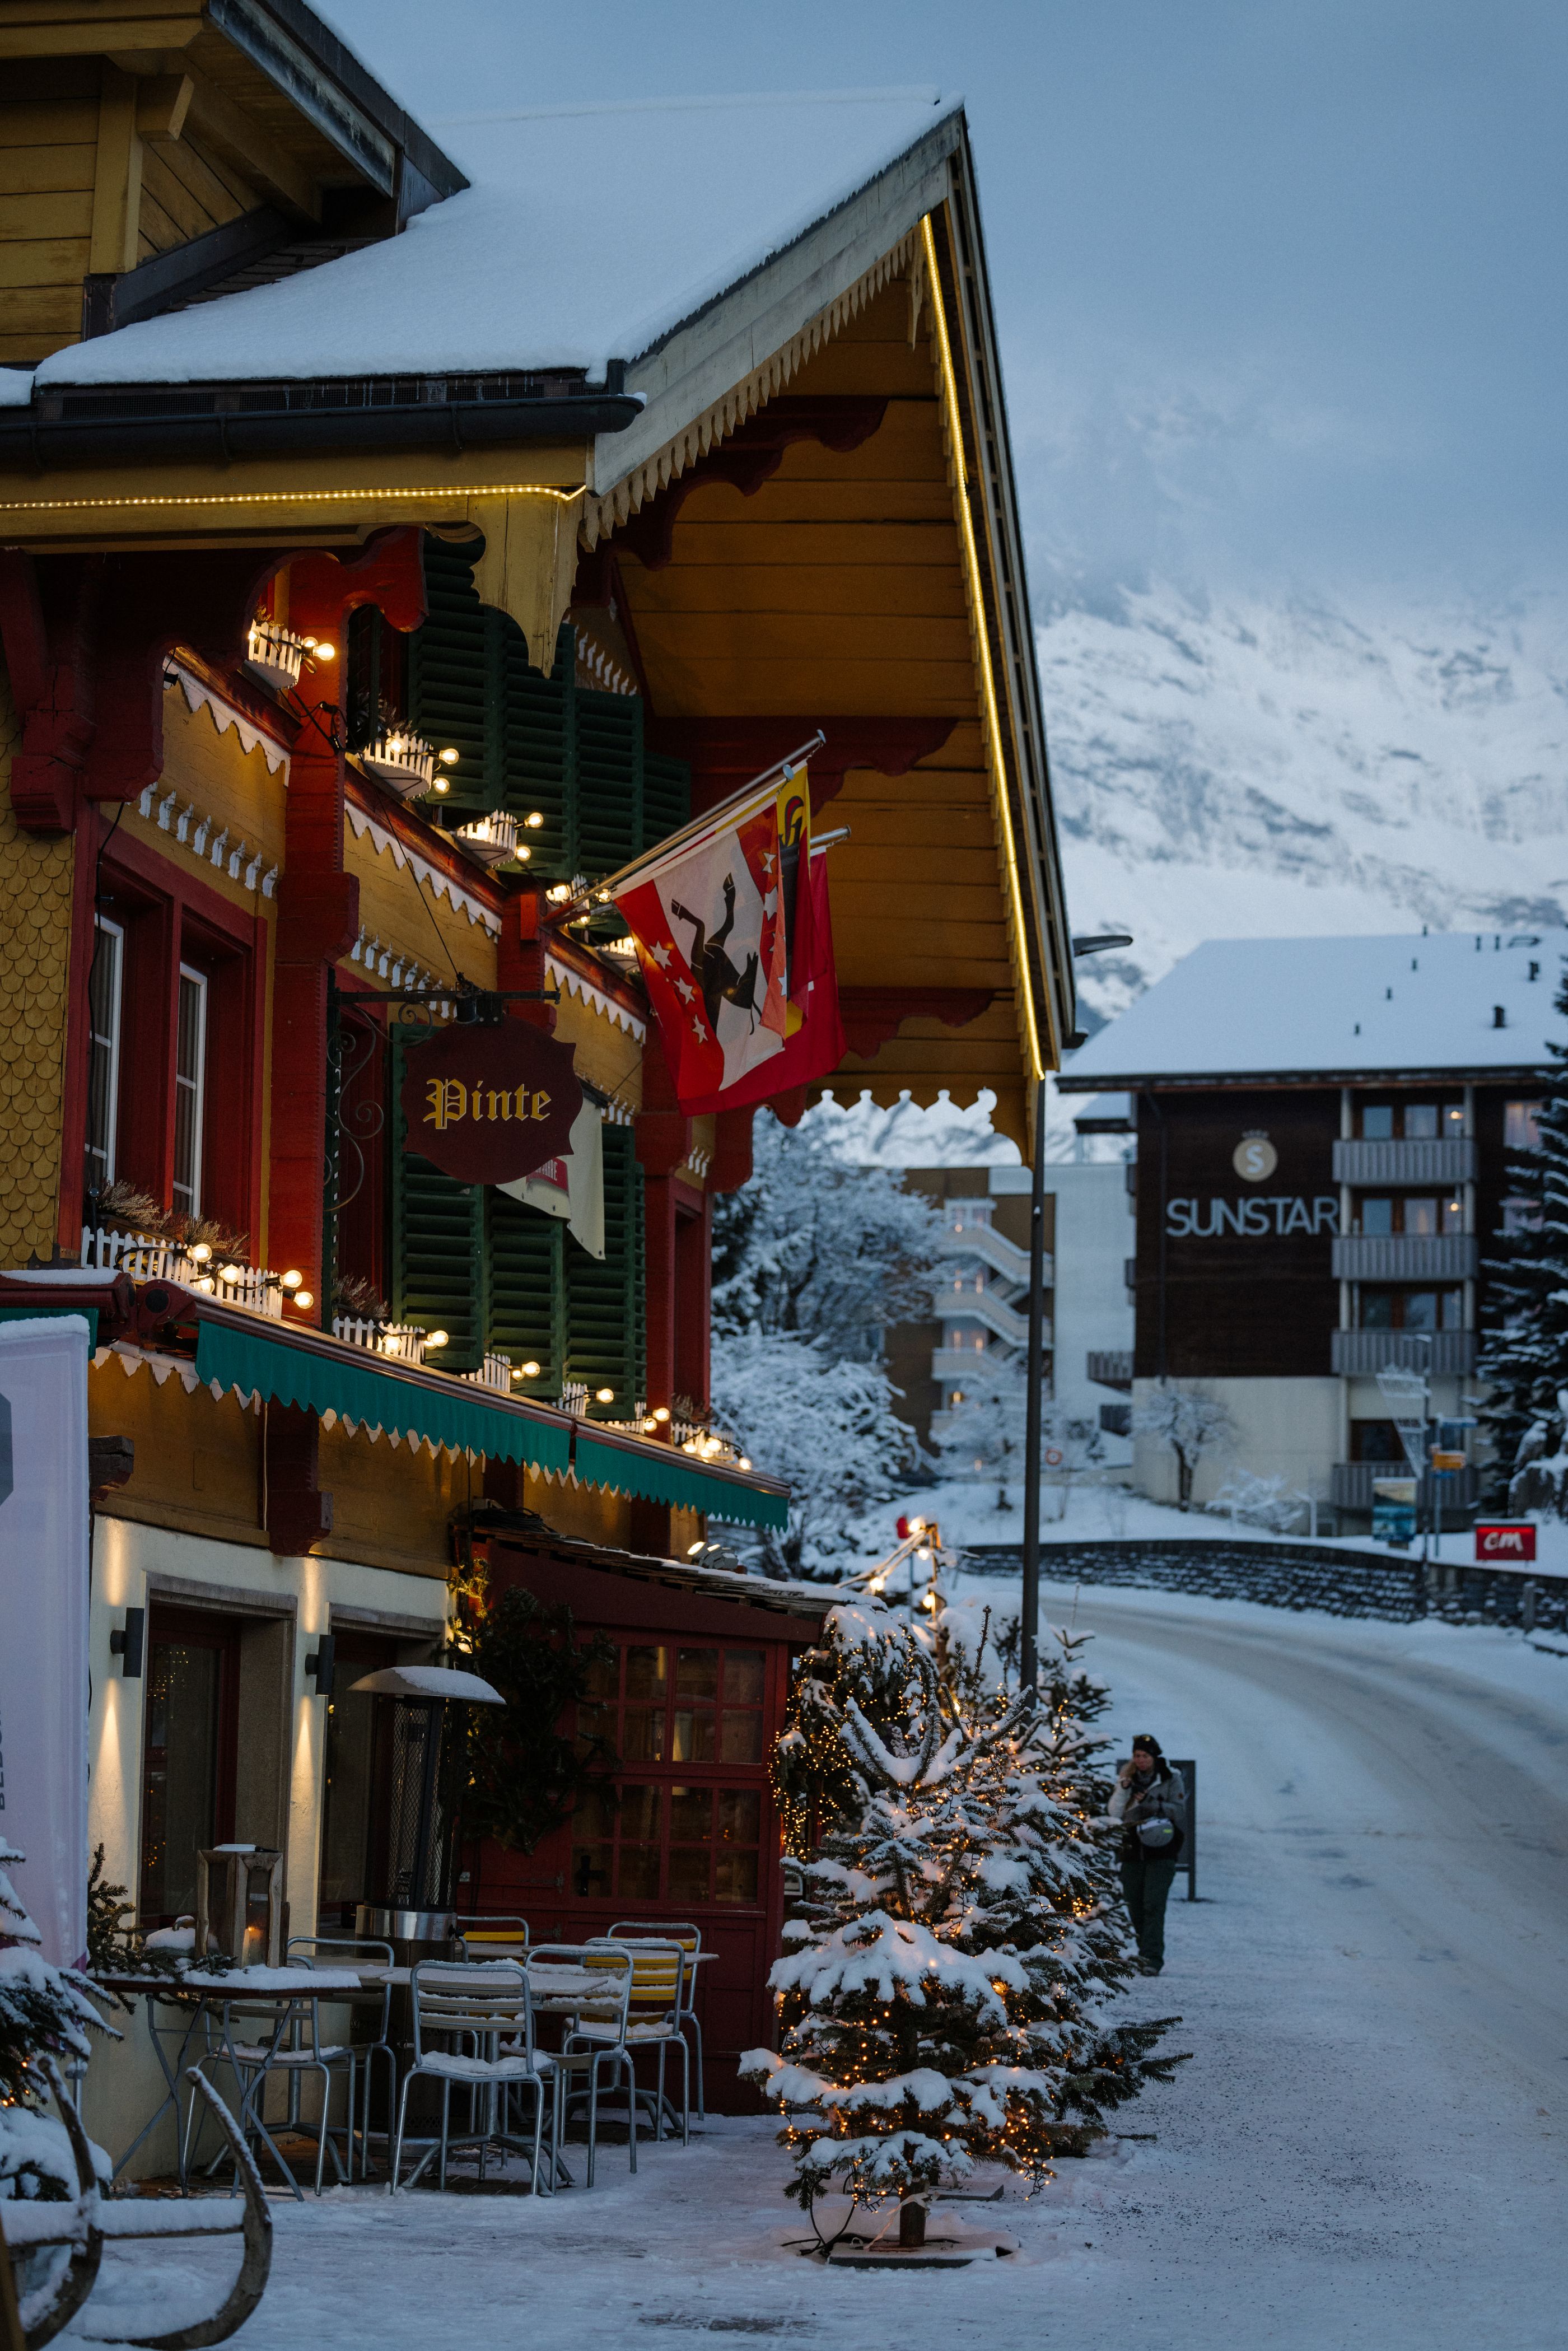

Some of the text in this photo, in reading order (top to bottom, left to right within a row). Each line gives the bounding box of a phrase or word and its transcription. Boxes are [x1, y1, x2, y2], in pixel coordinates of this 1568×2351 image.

[423, 1079, 552, 1129] Pinte
[1245, 1145, 1264, 1174] S
[1165, 1196, 1340, 1237] SUNSTAR
